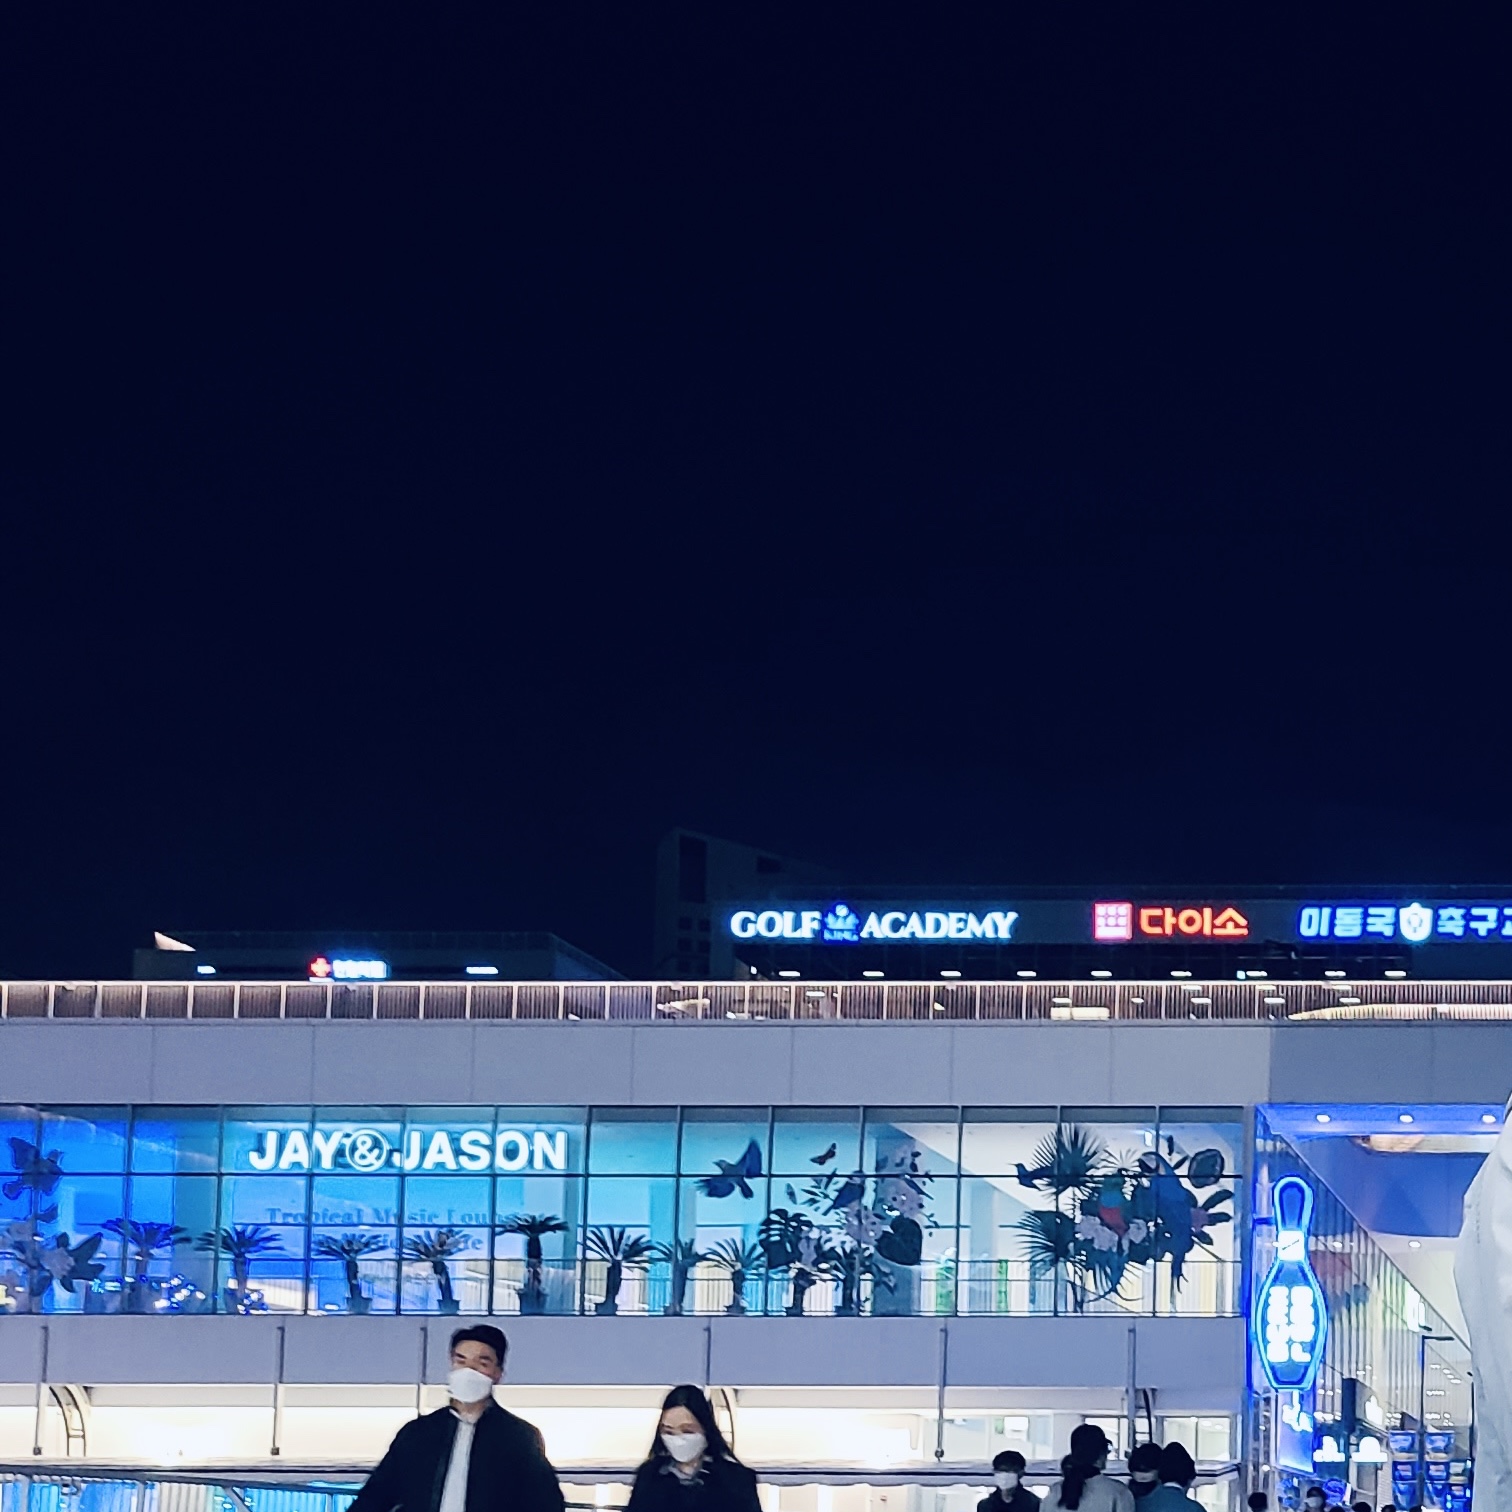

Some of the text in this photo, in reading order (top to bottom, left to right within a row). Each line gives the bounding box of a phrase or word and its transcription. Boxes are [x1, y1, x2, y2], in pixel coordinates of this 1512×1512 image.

[729, 909, 1019, 939] GOLF ACADEMY
[1139, 906, 1249, 936] 다이소
[1300, 906, 1397, 937] 이동국
